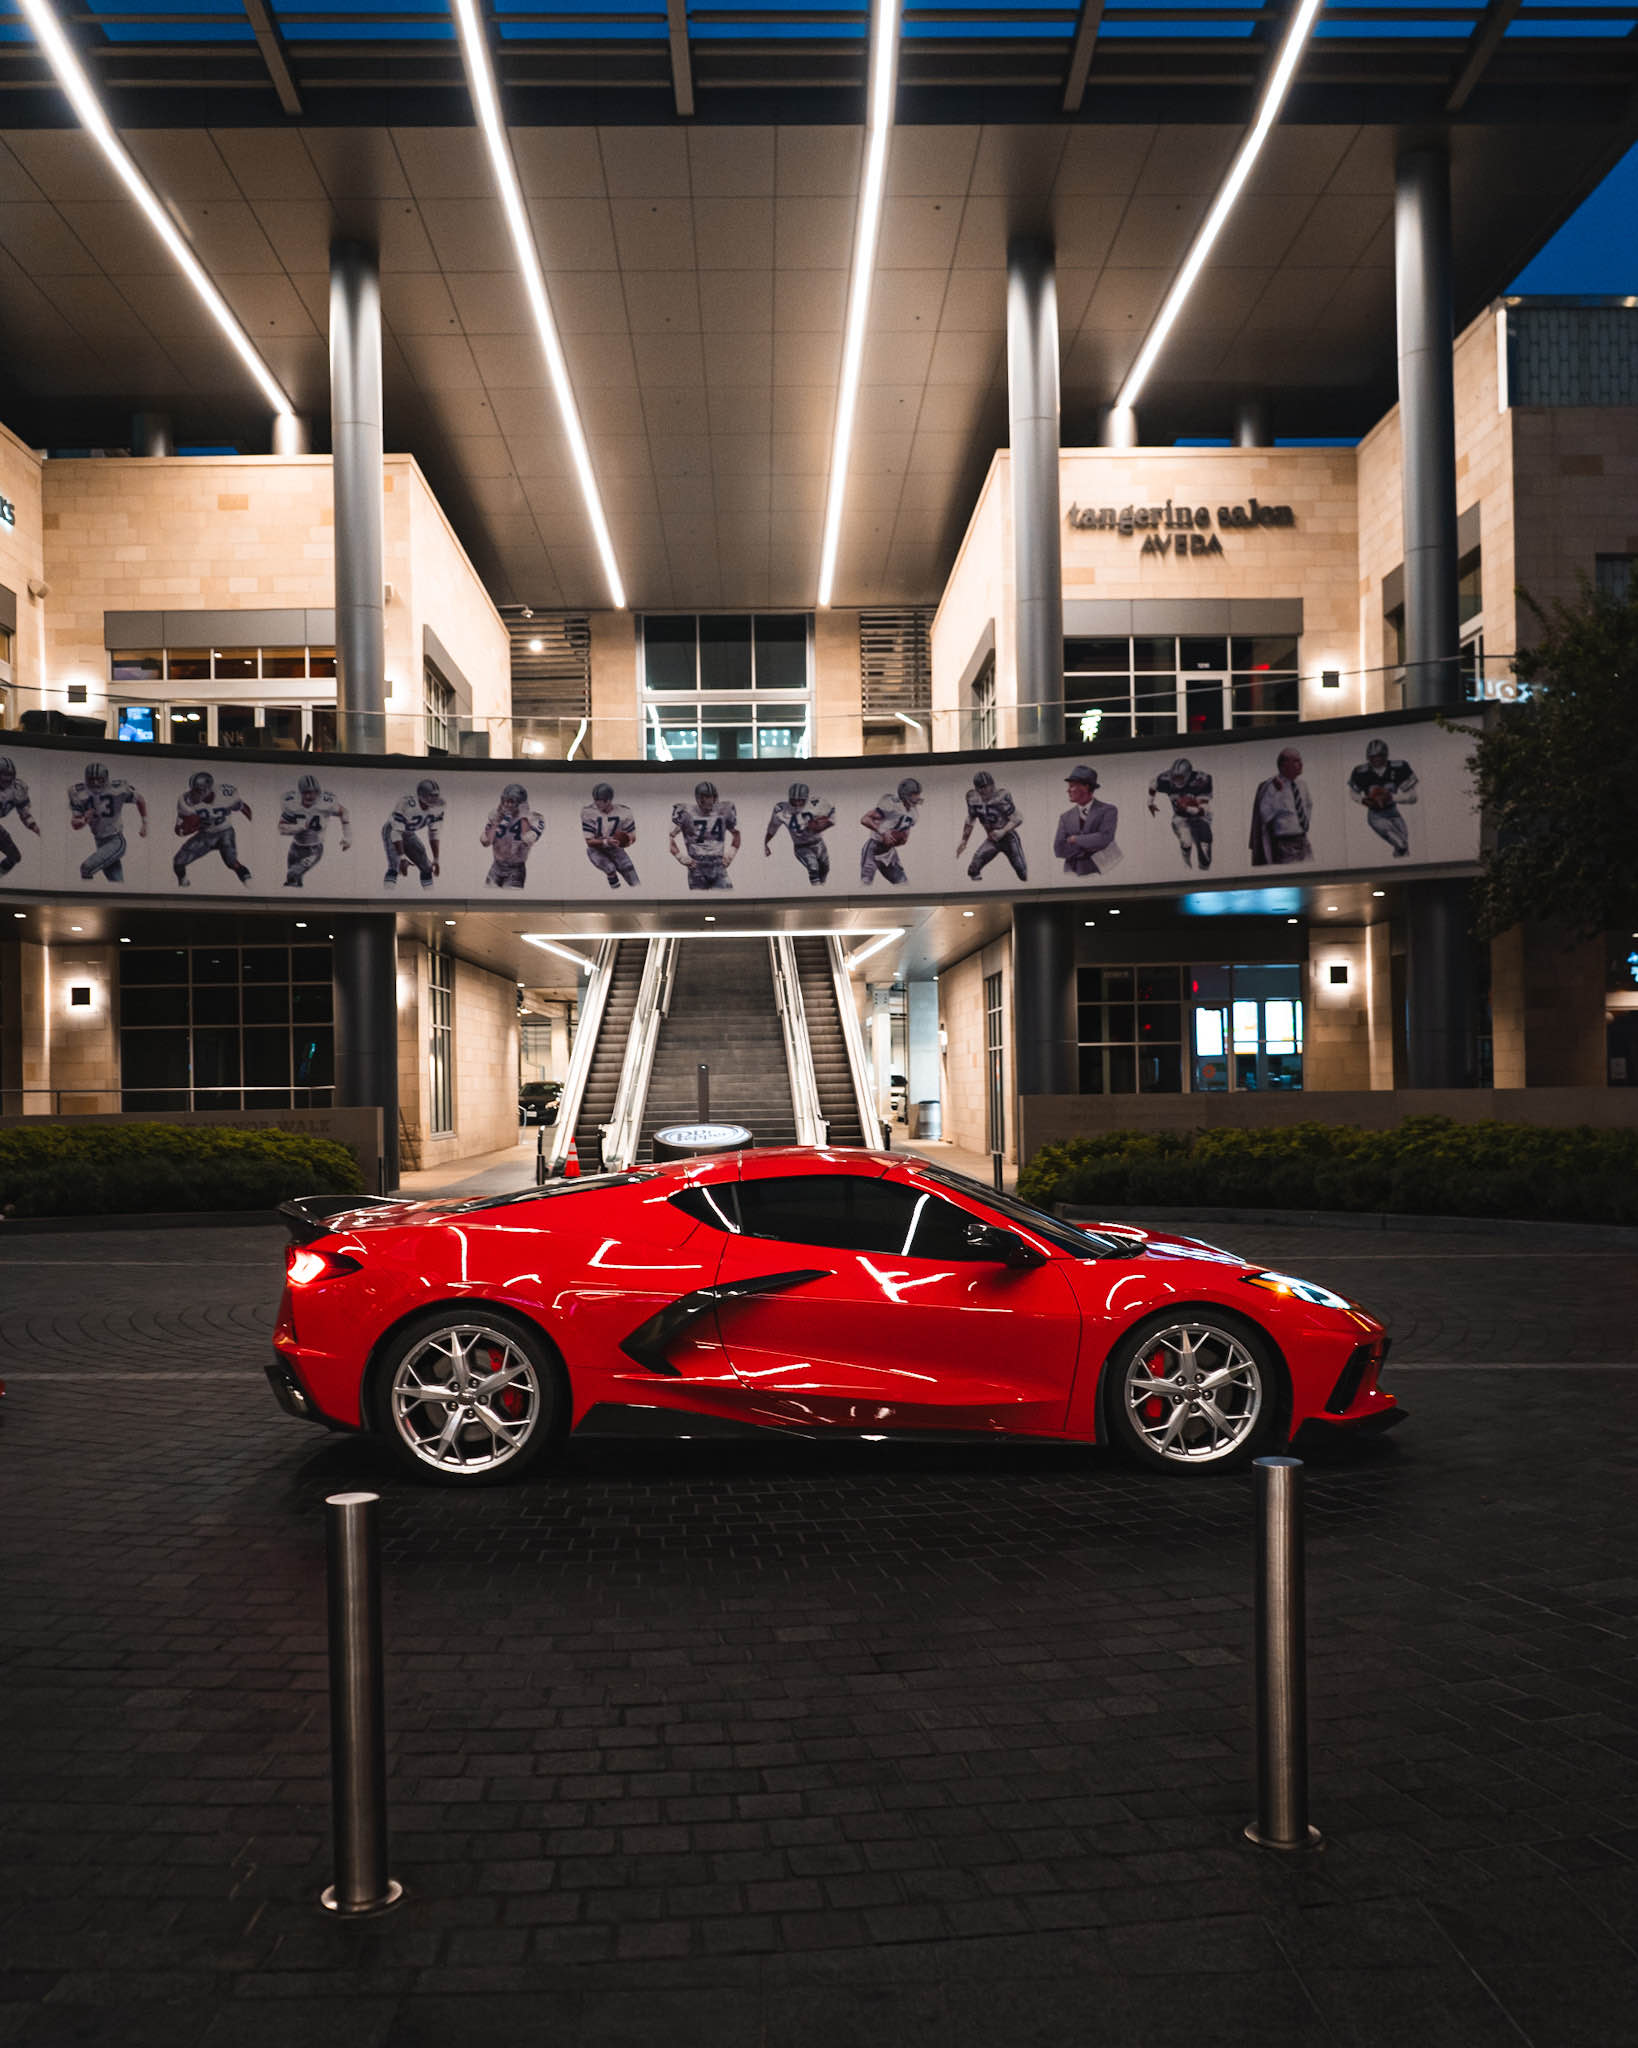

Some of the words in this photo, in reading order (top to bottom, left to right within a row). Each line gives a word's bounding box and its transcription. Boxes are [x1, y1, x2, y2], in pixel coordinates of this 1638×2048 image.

[1067, 499, 1211, 536] tangerine
[1216, 498, 1296, 528] salon
[1139, 533, 1224, 556] AVEDA
[596, 815, 621, 838] 17
[693, 817, 724, 844] 74
